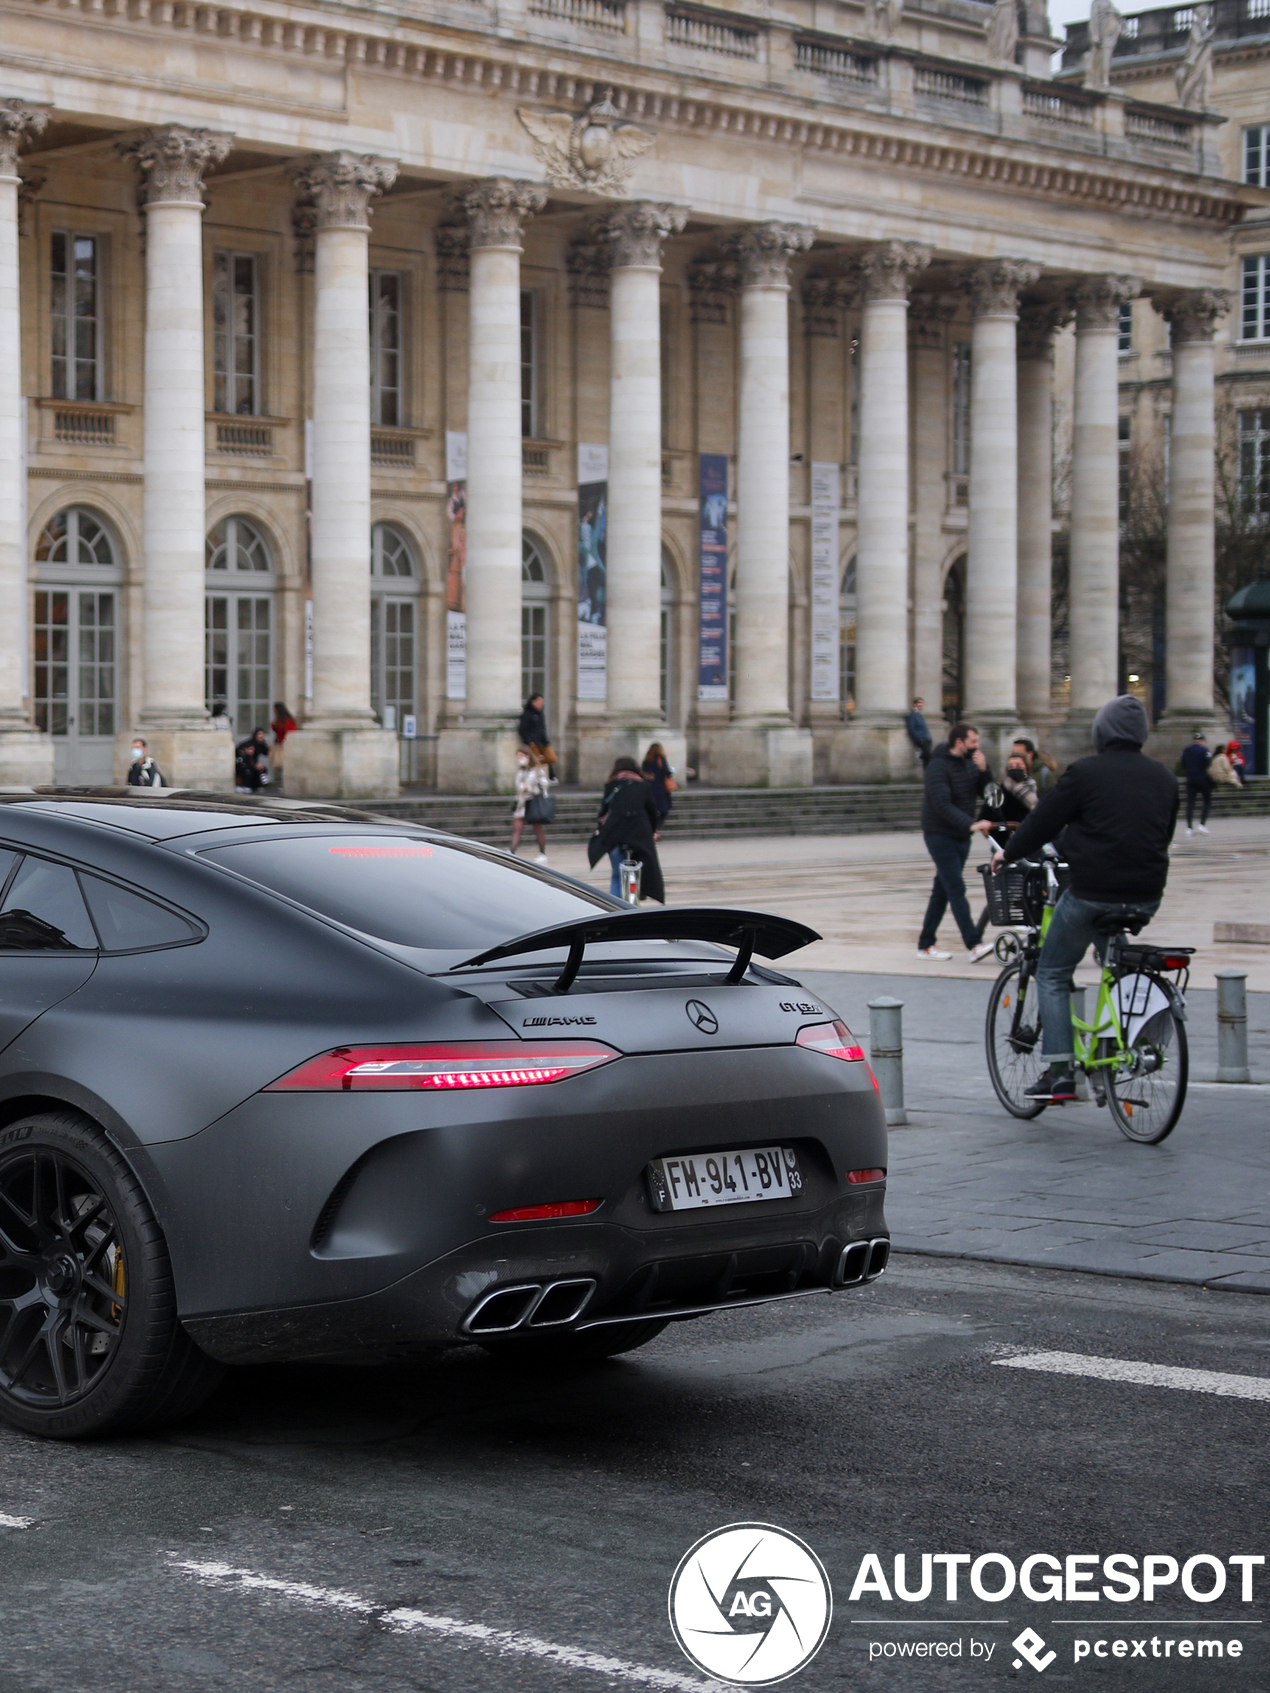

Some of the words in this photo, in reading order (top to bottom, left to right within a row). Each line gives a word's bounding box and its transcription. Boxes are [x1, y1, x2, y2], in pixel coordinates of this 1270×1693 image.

[547, 1016, 597, 1026] AMG
[666, 1151, 783, 1199] FM-941-BV
[788, 1170, 803, 1189] 33
[659, 1190, 666, 1203] F
